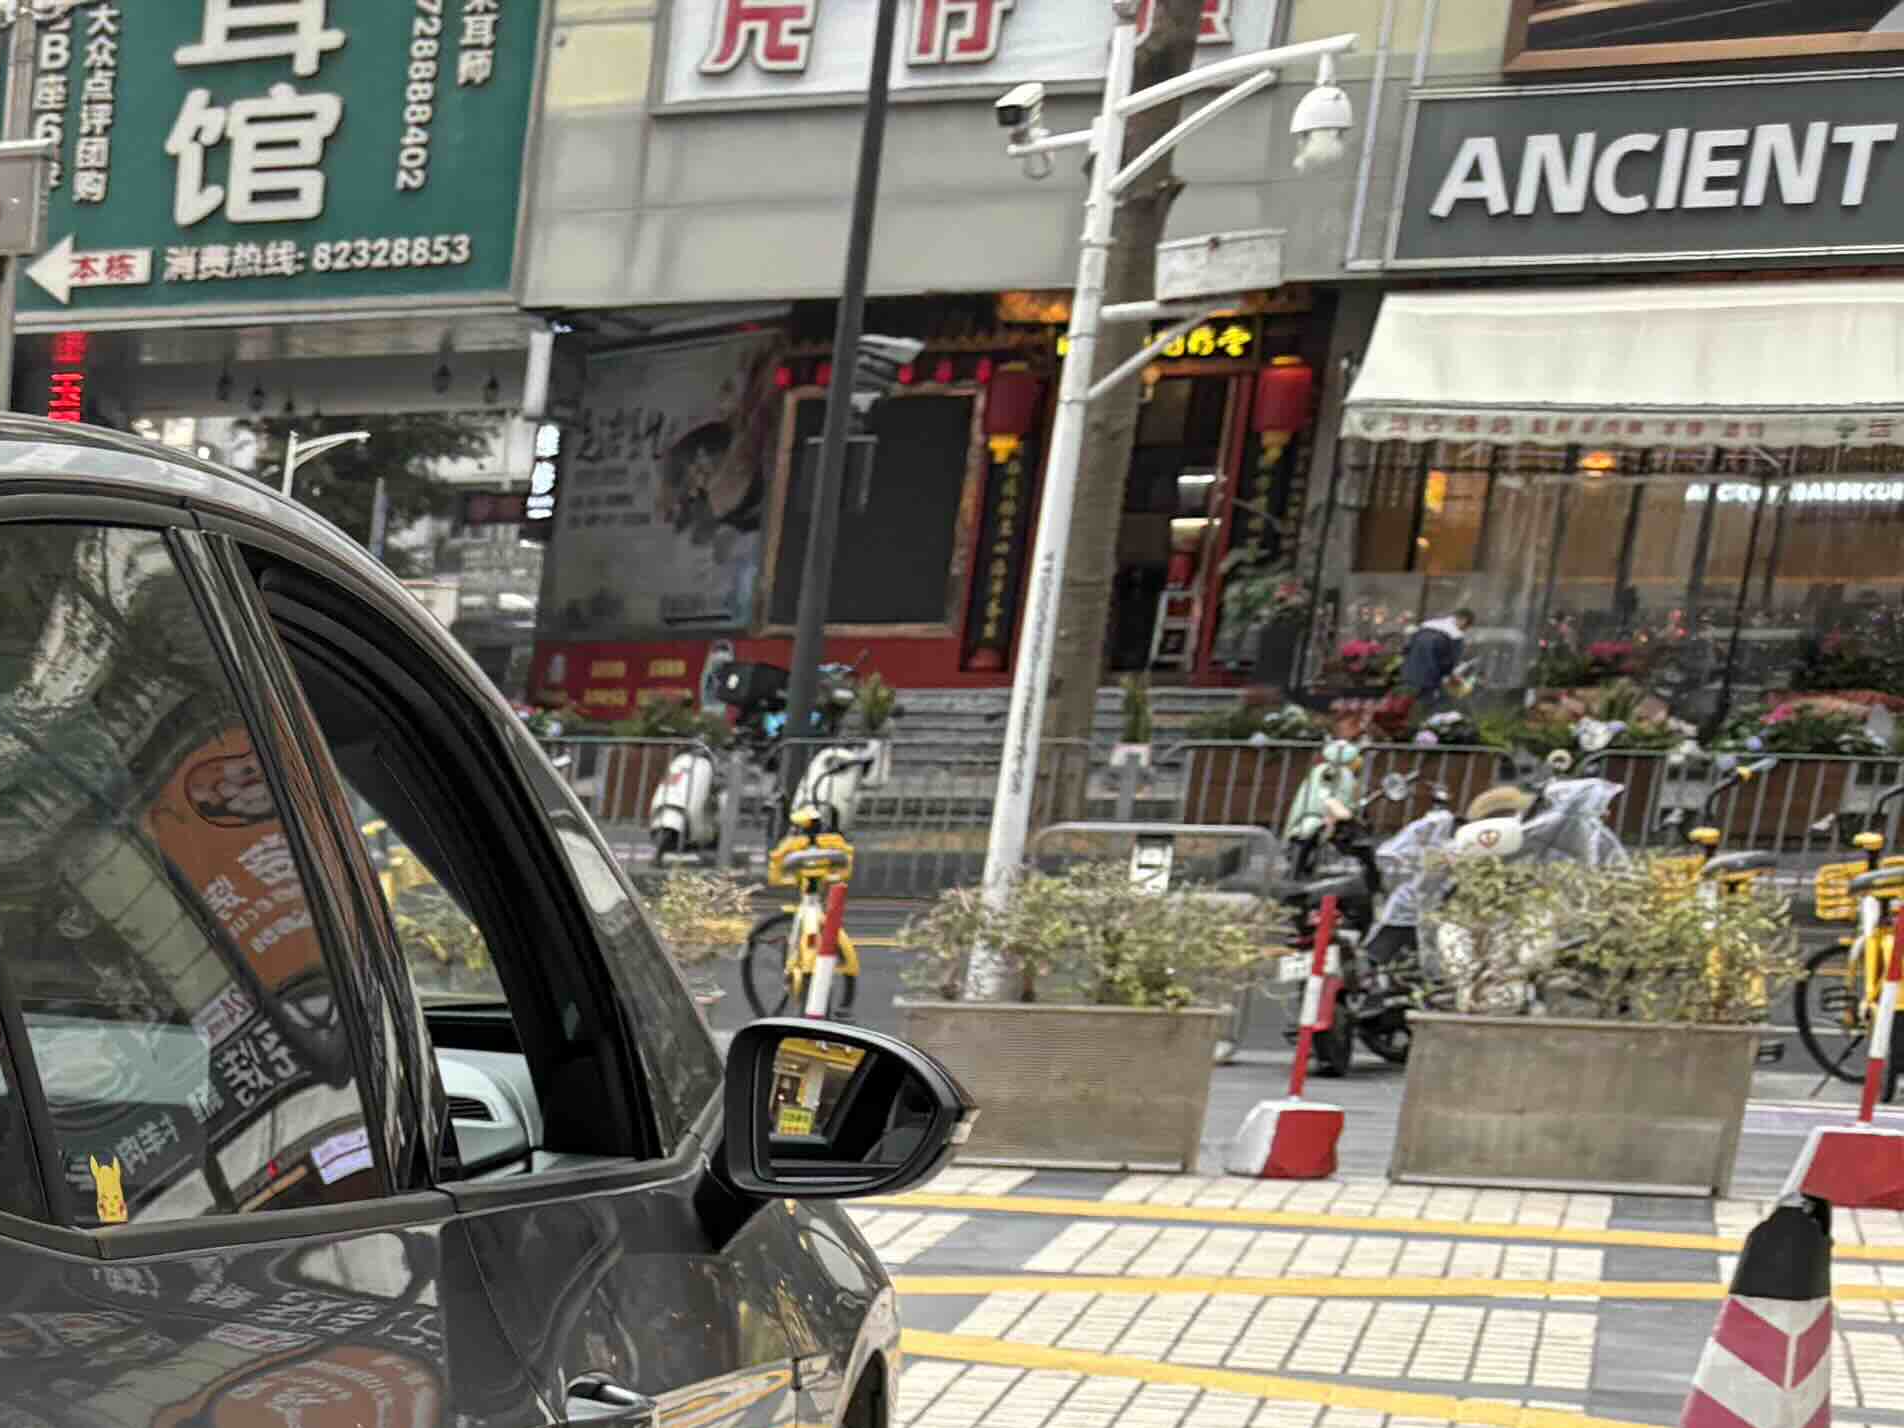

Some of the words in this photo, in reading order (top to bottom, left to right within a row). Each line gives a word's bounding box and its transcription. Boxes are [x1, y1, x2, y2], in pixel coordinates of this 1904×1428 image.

[1429, 120, 1898, 219] ANCIENT
[69, 254, 136, 281] 本栋
[163, 247, 305, 281] 消费热线:
[312, 234, 471, 272] 82328853
